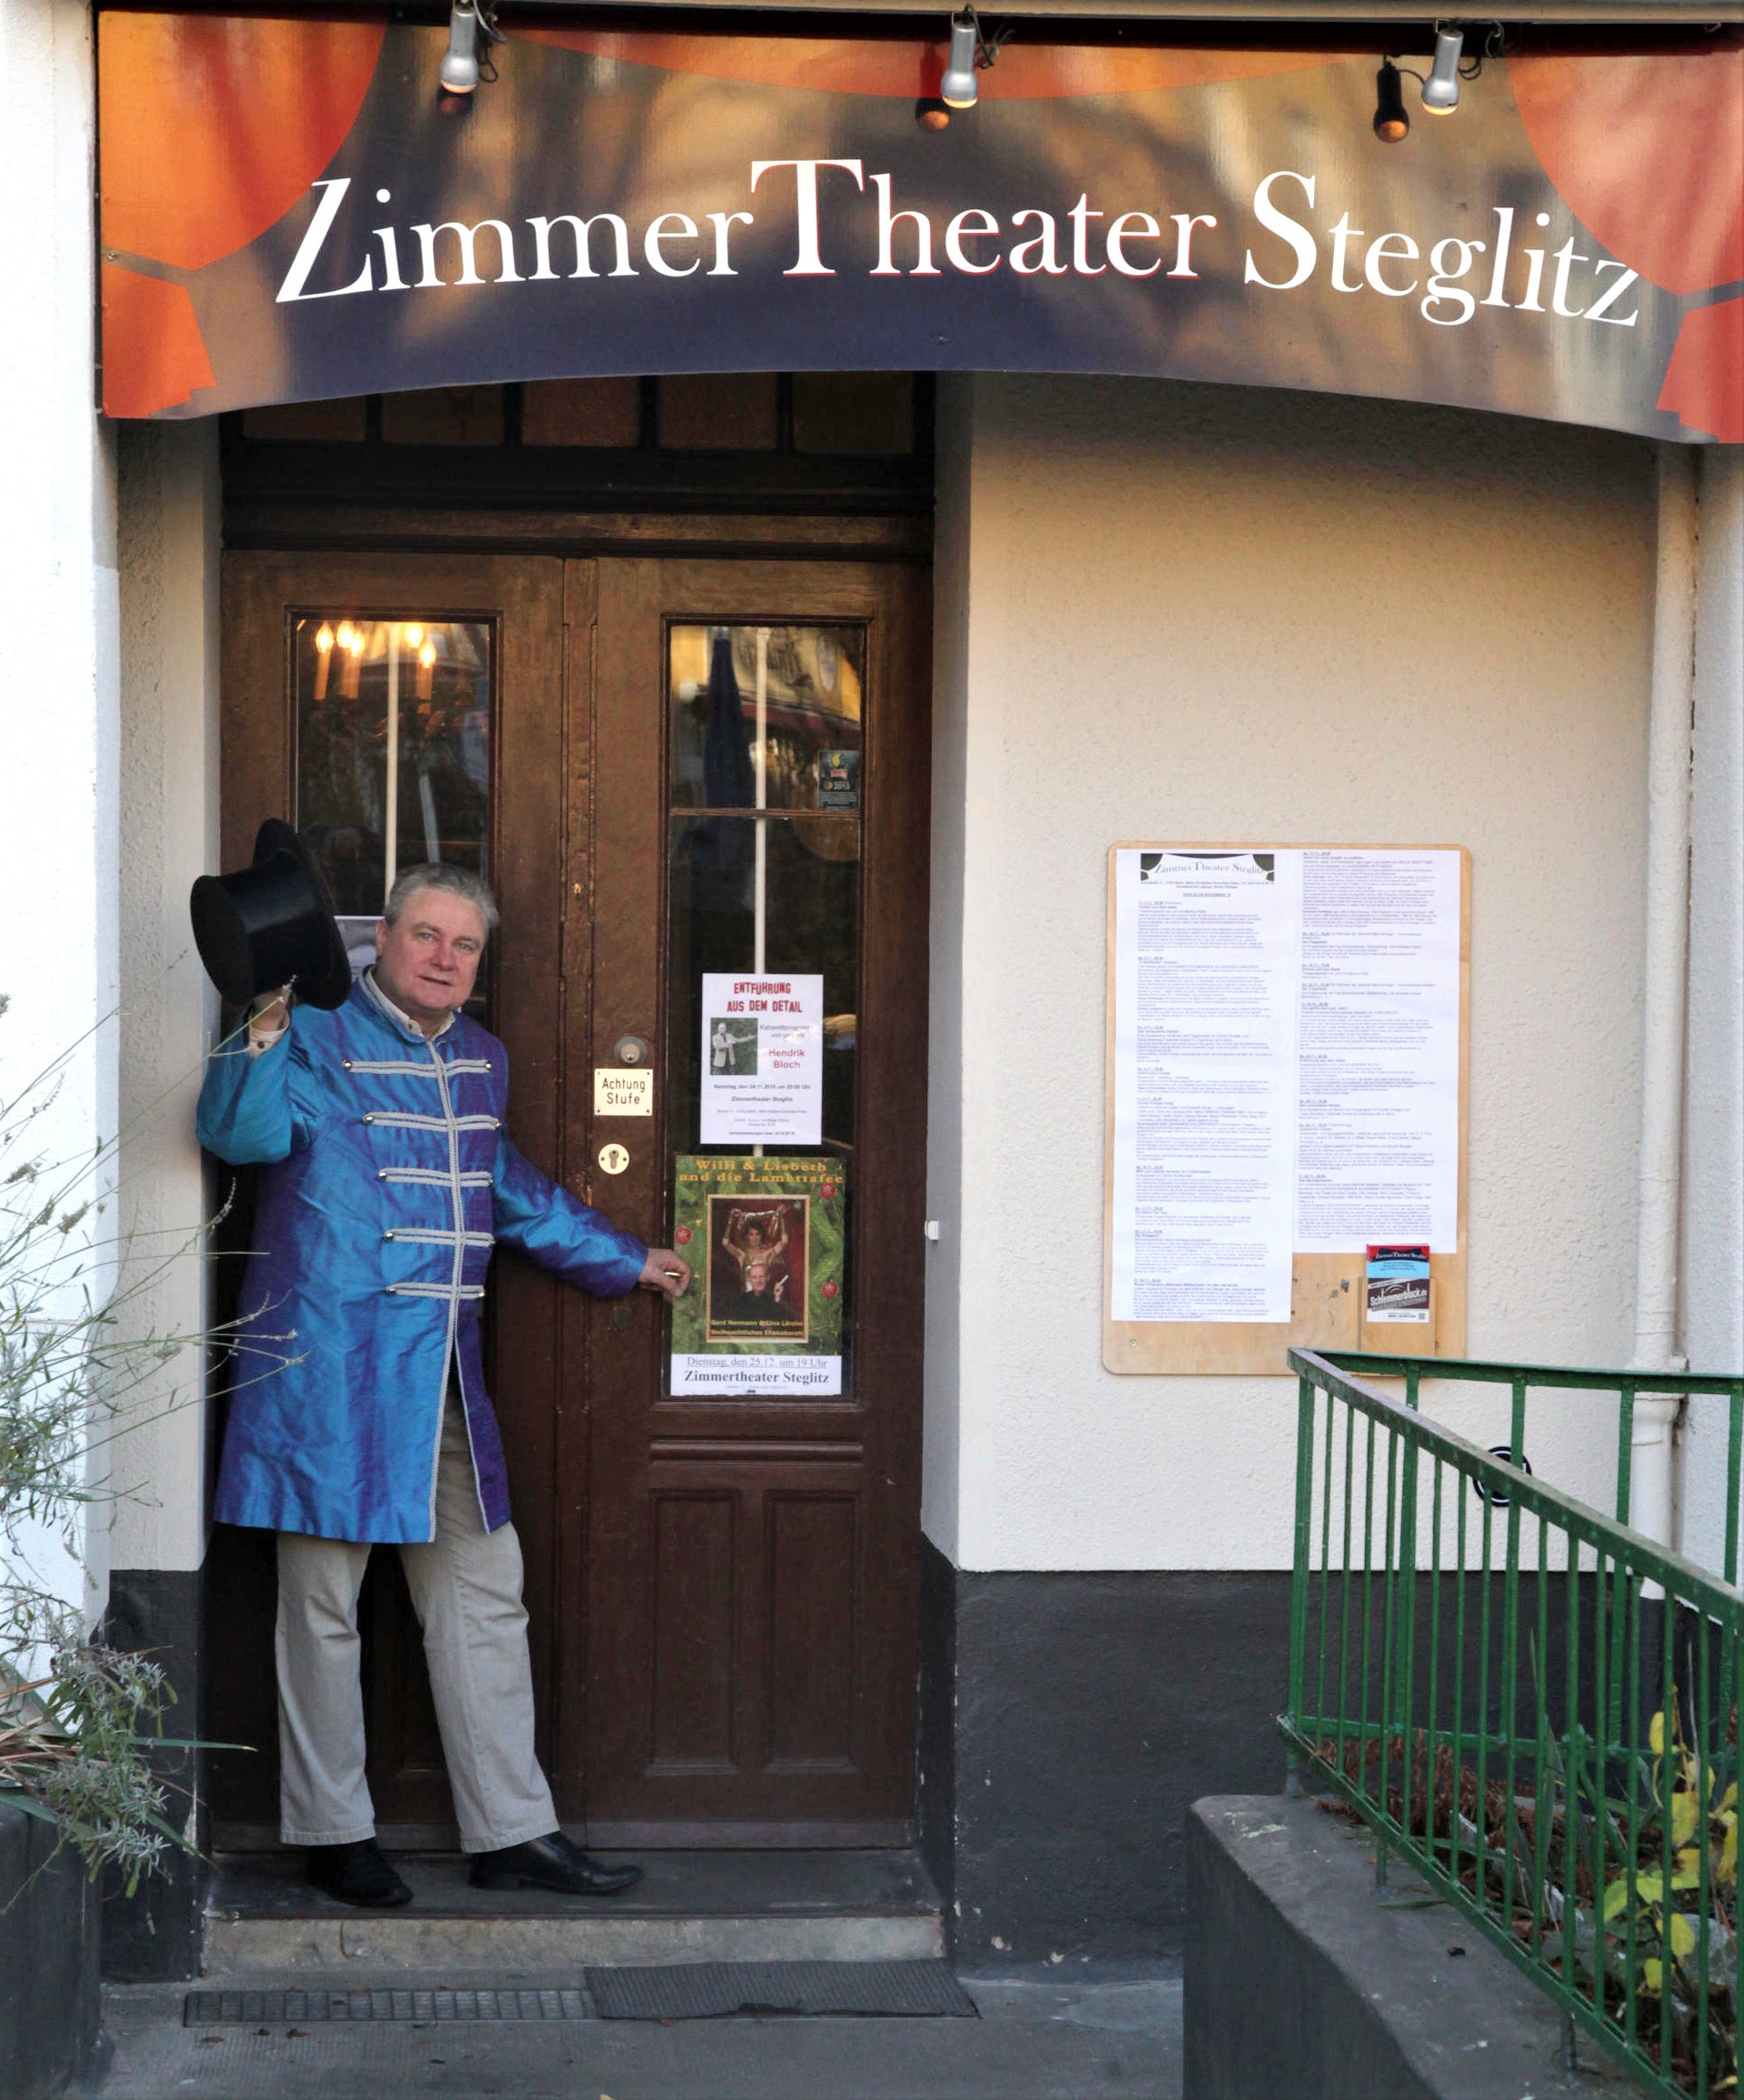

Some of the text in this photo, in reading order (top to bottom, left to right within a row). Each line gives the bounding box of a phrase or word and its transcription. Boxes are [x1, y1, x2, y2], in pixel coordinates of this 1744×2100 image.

[276, 158, 1639, 327] ZimmerTheater Steglitz
[1231, 861, 1265, 875] Steglitz
[727, 1000, 802, 1013] AUS DEM DETAIL
[768, 1049, 806, 1057] Hendrik
[773, 1060, 800, 1069] Bloch
[602, 1077, 646, 1093] Achtung
[606, 1091, 640, 1104] Stufe
[696, 1160, 827, 1172] Willi & Lisbeth
[679, 1171, 709, 1182] und
[717, 1171, 742, 1182] die
[731, 1357, 747, 1366] den
[797, 1358, 807, 1367] 19
[810, 1358, 827, 1368] Uhr
[685, 1371, 829, 1385] Zimmertheater Steglitz
